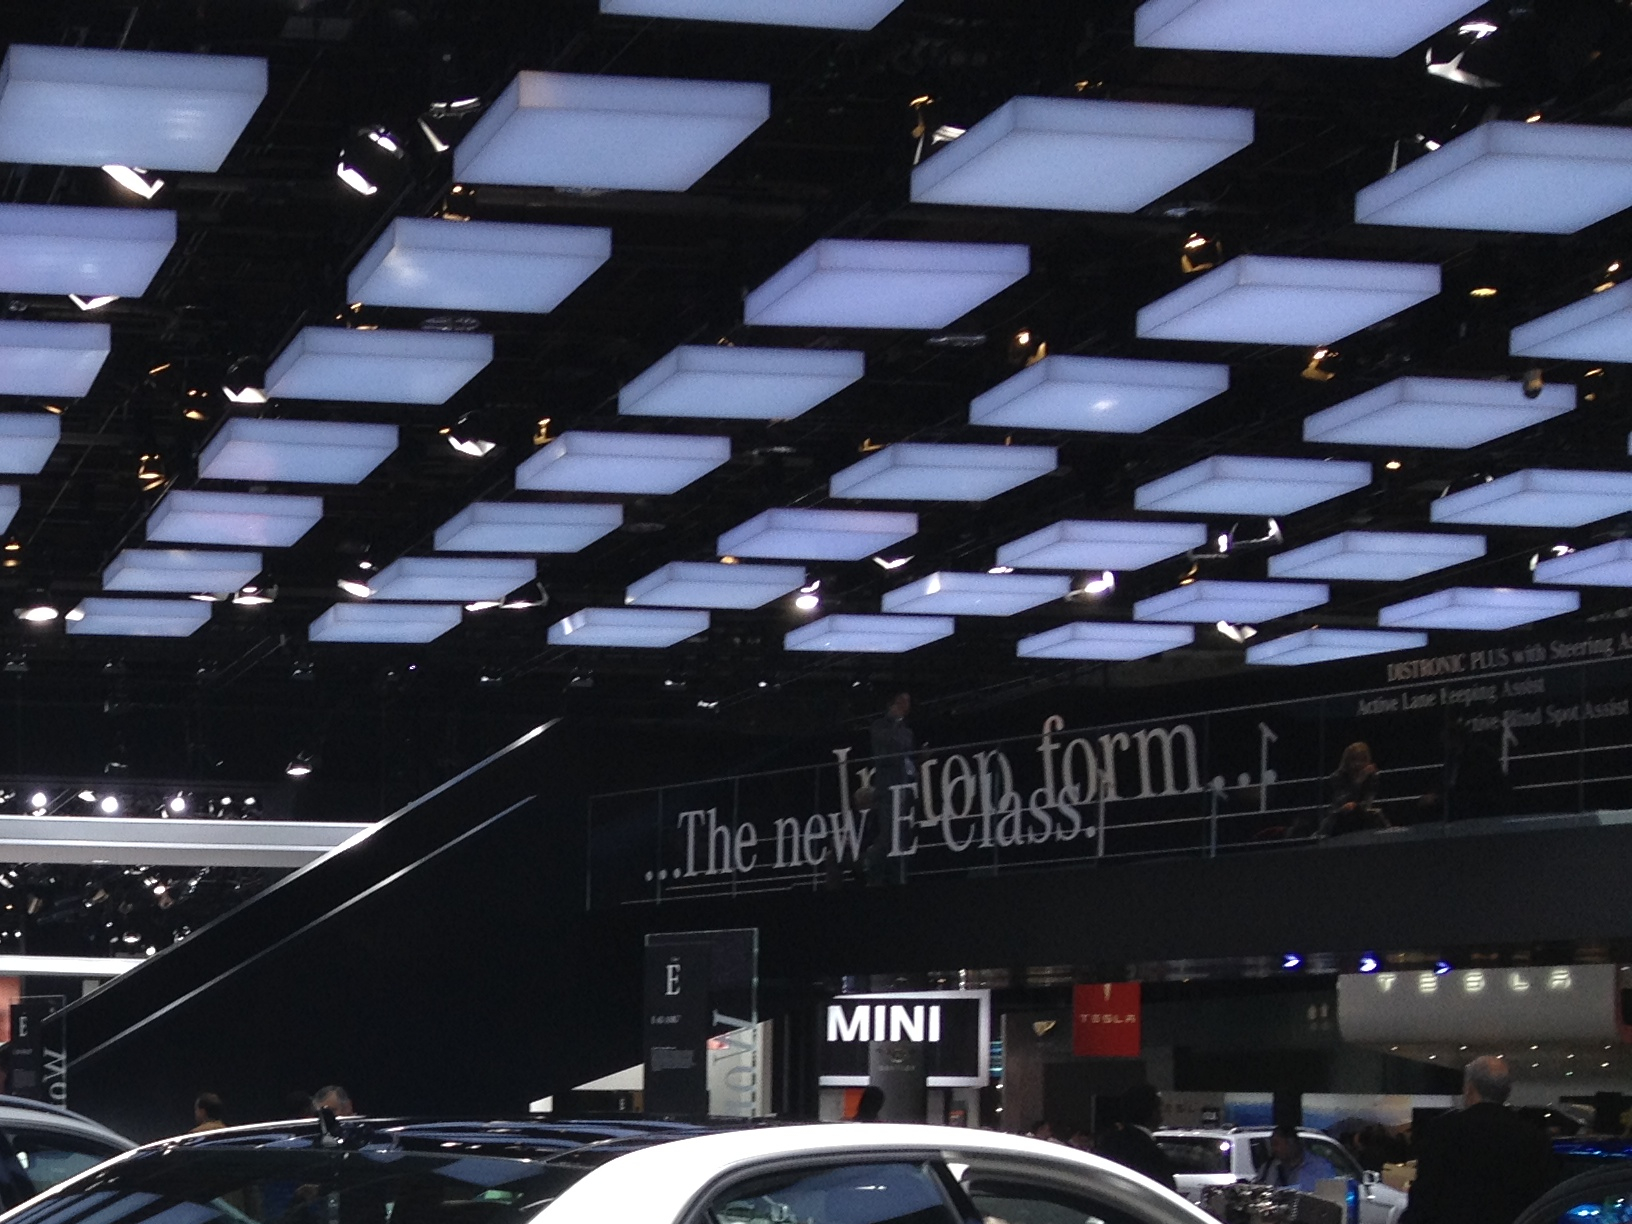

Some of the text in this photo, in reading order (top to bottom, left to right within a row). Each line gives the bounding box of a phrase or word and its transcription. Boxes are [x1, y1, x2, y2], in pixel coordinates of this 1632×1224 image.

[1387, 653, 1466, 683] DISTRONIC
[1470, 648, 1509, 672] PLUS
[1512, 642, 1547, 664] with
[1550, 635, 1614, 660] Steering
[1356, 676, 1546, 717] Active Lane Keeping Assist
[1502, 706, 1543, 729] Blind
[1546, 704, 1580, 727] Spot
[1583, 698, 1631, 720] Assist
[774, 807, 871, 869] new
[664, 963, 682, 996] E
[1376, 970, 1574, 994] TESLA
[826, 1005, 942, 1043] MINI
[1079, 1013, 1137, 1024] TESLA
